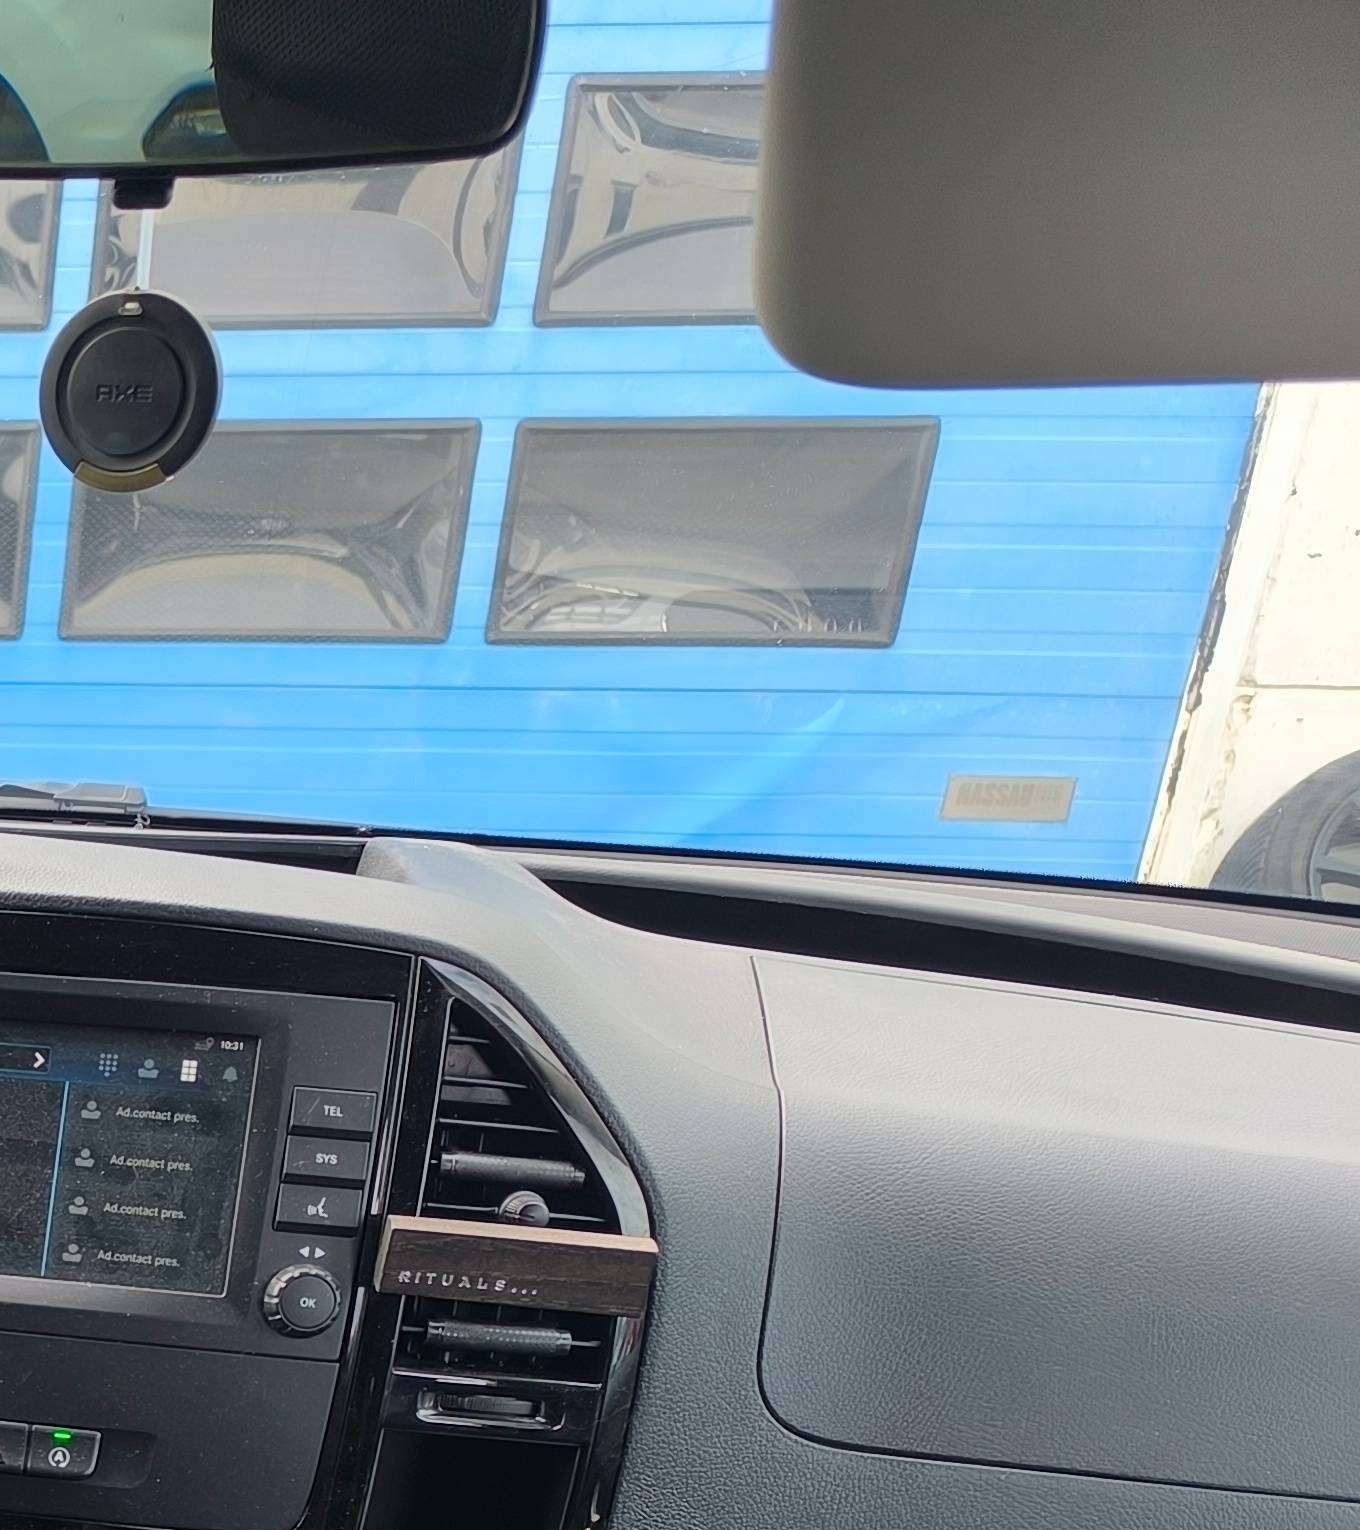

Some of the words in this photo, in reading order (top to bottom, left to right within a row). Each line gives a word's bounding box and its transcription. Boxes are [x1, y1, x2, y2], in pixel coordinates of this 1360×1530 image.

[220, 1041, 244, 1050] 10:31
[116, 1107, 172, 1121] Ad.contact
[174, 1112, 200, 1123] pres.
[323, 1105, 344, 1117] TEL
[110, 1155, 165, 1169] Ad.contact
[167, 1160, 193, 1172] pres.
[315, 1153, 338, 1165] SYS
[103, 1203, 159, 1218] Ad.contact
[161, 1209, 187, 1220] pres.
[97, 1250, 152, 1265] Ad.contact
[154, 1257, 180, 1267] pres.
[299, 1297, 316, 1309] OK
